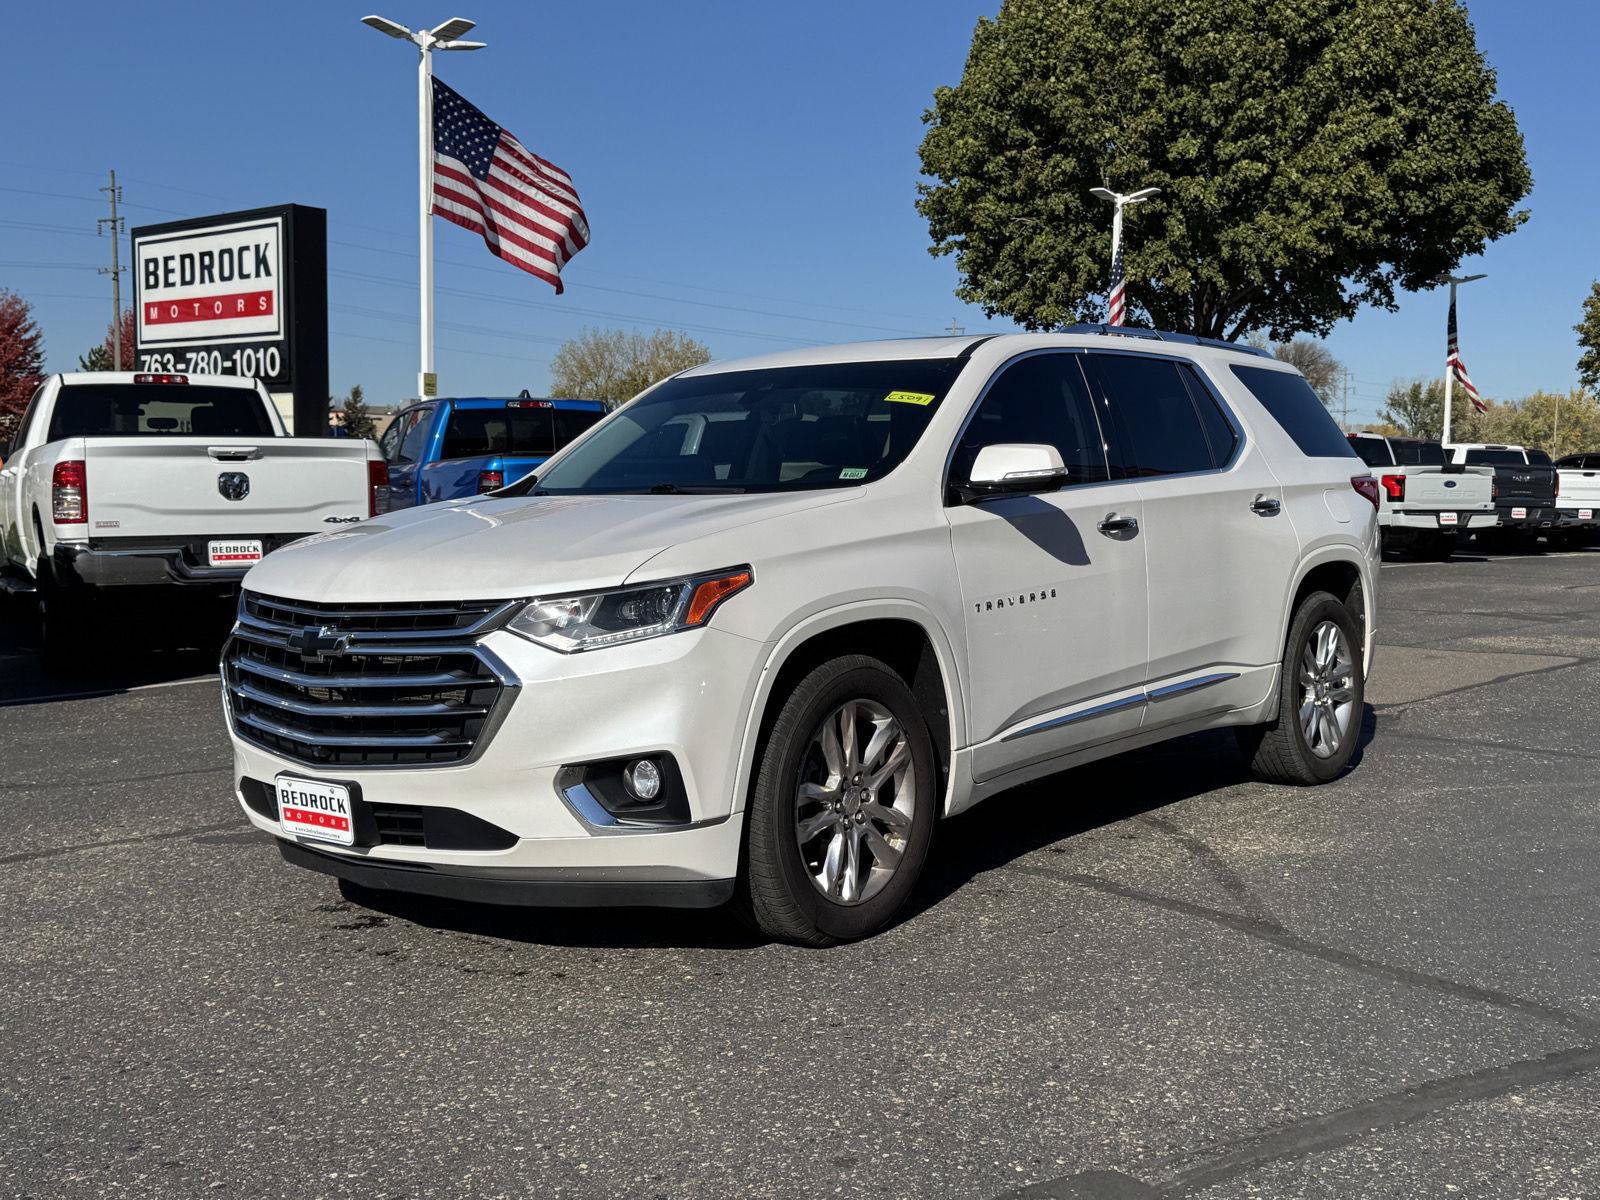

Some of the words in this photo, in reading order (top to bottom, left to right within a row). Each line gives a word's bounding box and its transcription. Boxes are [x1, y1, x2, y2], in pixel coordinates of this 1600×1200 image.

[144, 242, 272, 290] BEDROCK
[150, 296, 267, 320] MOTORS
[140, 346, 281, 377] 763-780-1010
[212, 545, 260, 554] BEDROCK
[975, 588, 1057, 613] TRAVERSE
[281, 789, 347, 814] BEDROCK
